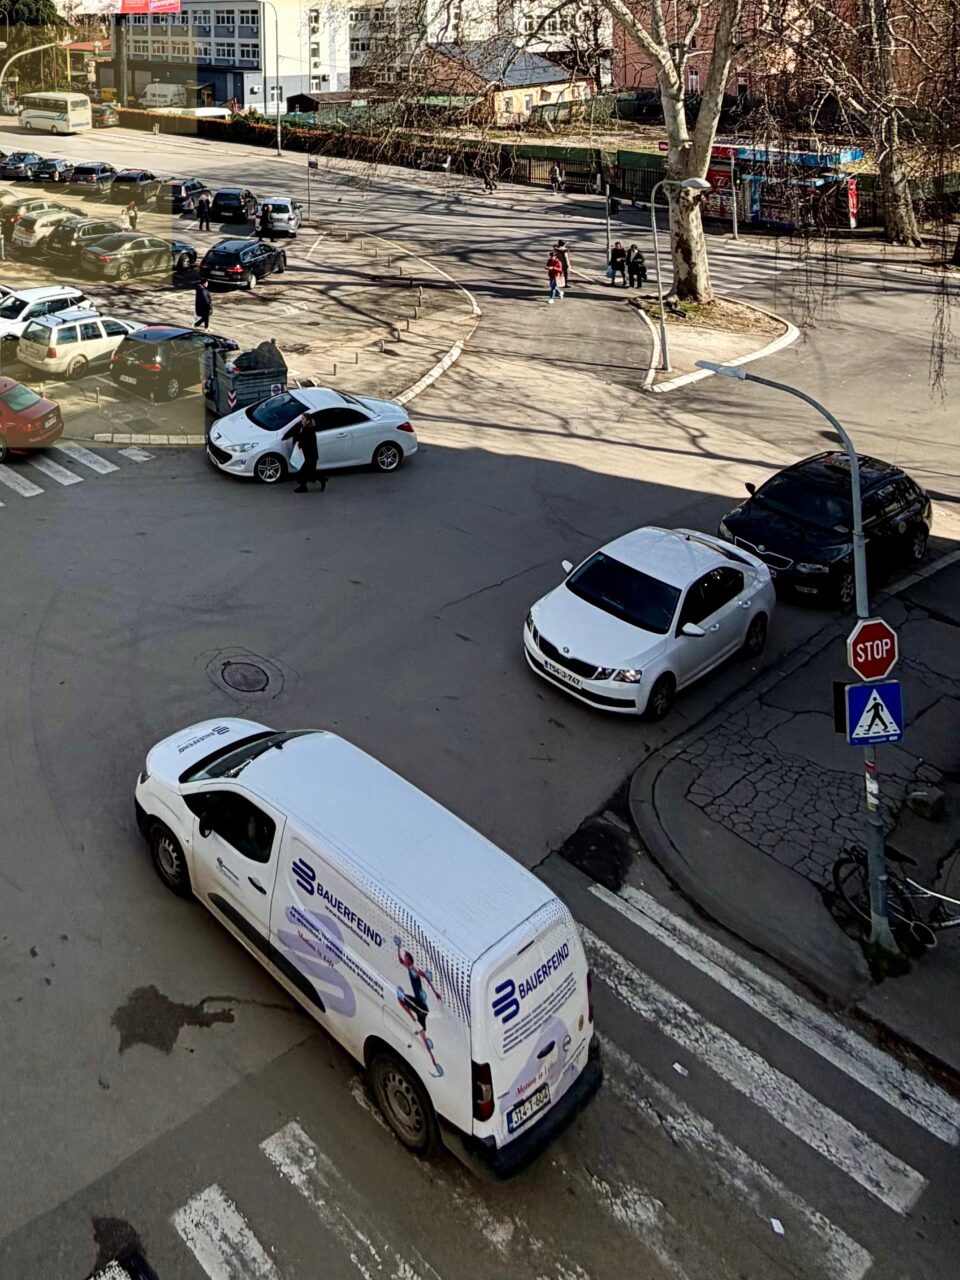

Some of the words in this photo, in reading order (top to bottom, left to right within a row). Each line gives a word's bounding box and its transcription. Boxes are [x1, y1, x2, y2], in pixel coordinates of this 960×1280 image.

[856, 638, 891, 663] STOP
[316, 882, 383, 948] BAUERFEIND
[517, 942, 570, 1000] BAUERFEIND
